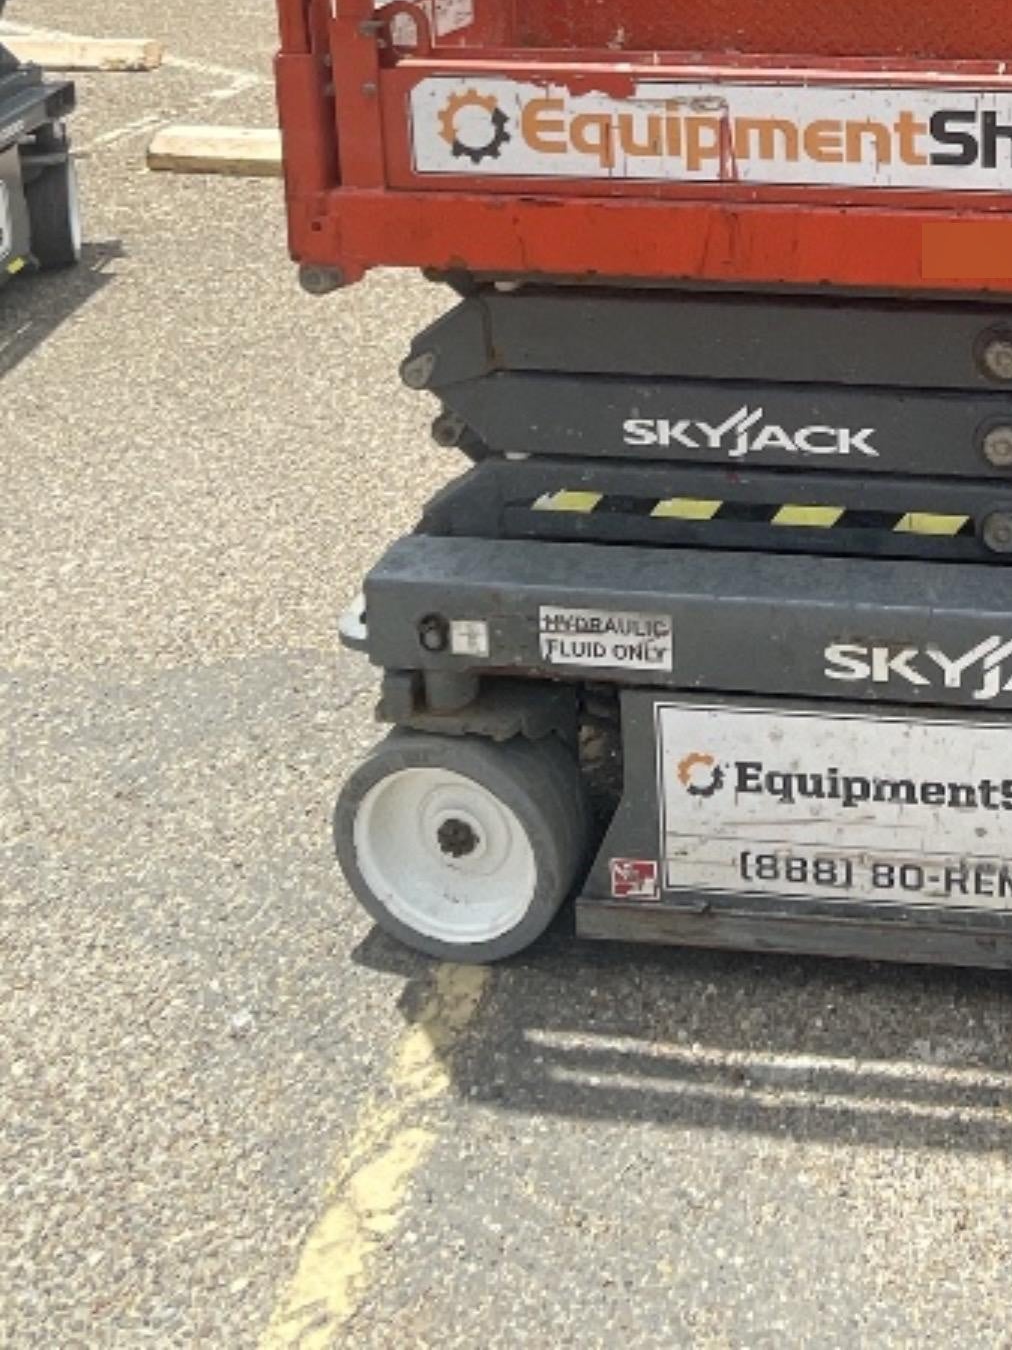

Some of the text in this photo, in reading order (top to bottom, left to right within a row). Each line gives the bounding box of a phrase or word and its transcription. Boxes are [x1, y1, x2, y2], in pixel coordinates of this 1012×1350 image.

[622, 405, 879, 457] SKYJACK
[543, 613, 670, 638] HYDRAULIC
[545, 638, 667, 663] FLUID ONLY
